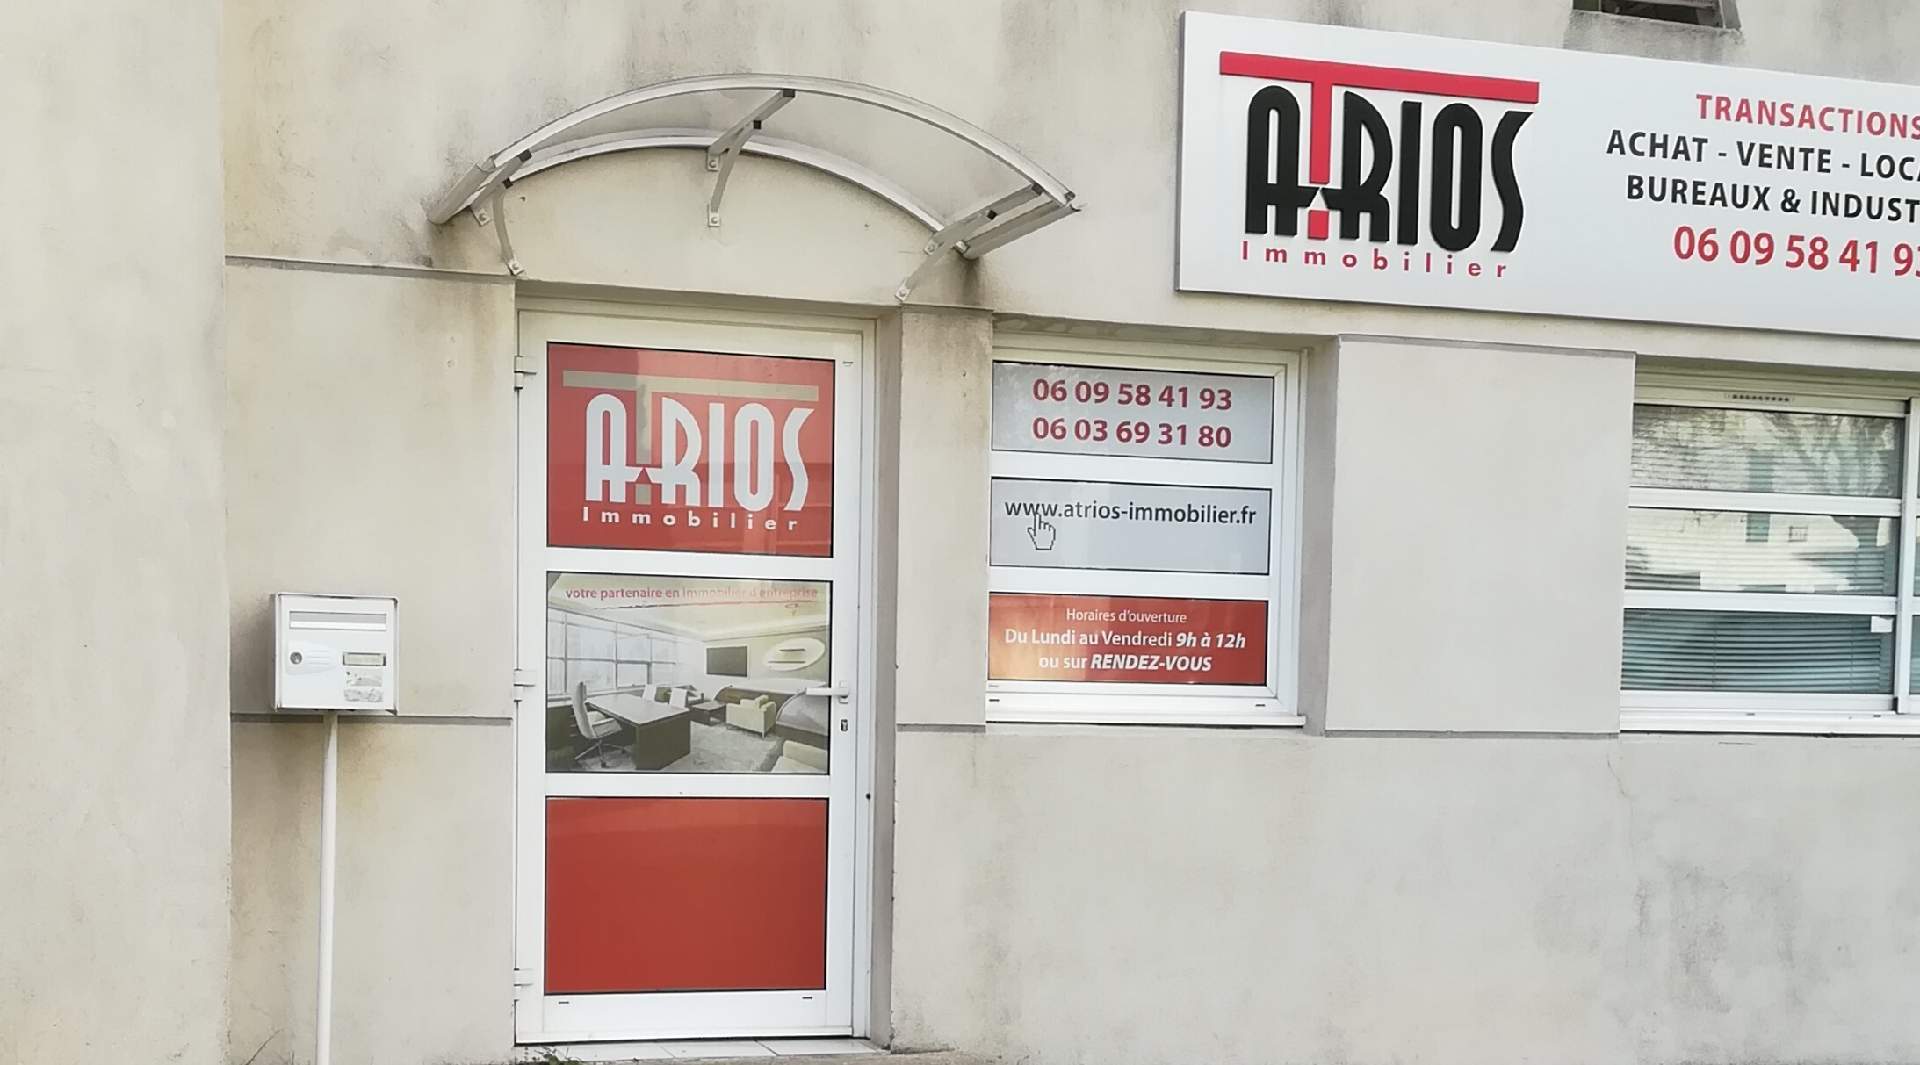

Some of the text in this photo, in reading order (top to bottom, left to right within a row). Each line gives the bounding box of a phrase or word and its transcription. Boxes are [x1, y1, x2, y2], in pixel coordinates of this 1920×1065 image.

[1696, 94, 1920, 140] TRANSACTIONS
[1220, 51, 1540, 255] ATRIOS
[1606, 130, 1708, 162] ACHAT
[1736, 141, 1831, 173] VENTE
[1860, 153, 1920, 182] LOC
[1627, 175, 1920, 223] BUREAUX & INDUST
[1242, 240, 1507, 278] Immobilier
[1674, 226, 1920, 278] 06 09 58 41 9
[1033, 378, 1232, 410] 06 09 58 41 93
[563, 370, 820, 512] ATRIOS
[1033, 417, 1232, 448] 06 03 69 31 80
[582, 506, 798, 531] Immobilier
[1005, 500, 1257, 525] www.atrios-immobilier.fr
[565, 587, 598, 599] votre
[600, 586, 663, 601] partenaire
[665, 589, 680, 599] en
[1066, 608, 1188, 624] Horaires d'ouverture
[1005, 628, 1246, 649] Du Lundi au Vendredi 9h à 12h
[1039, 654, 1212, 671] ou sur RENDEZ-VOUS
